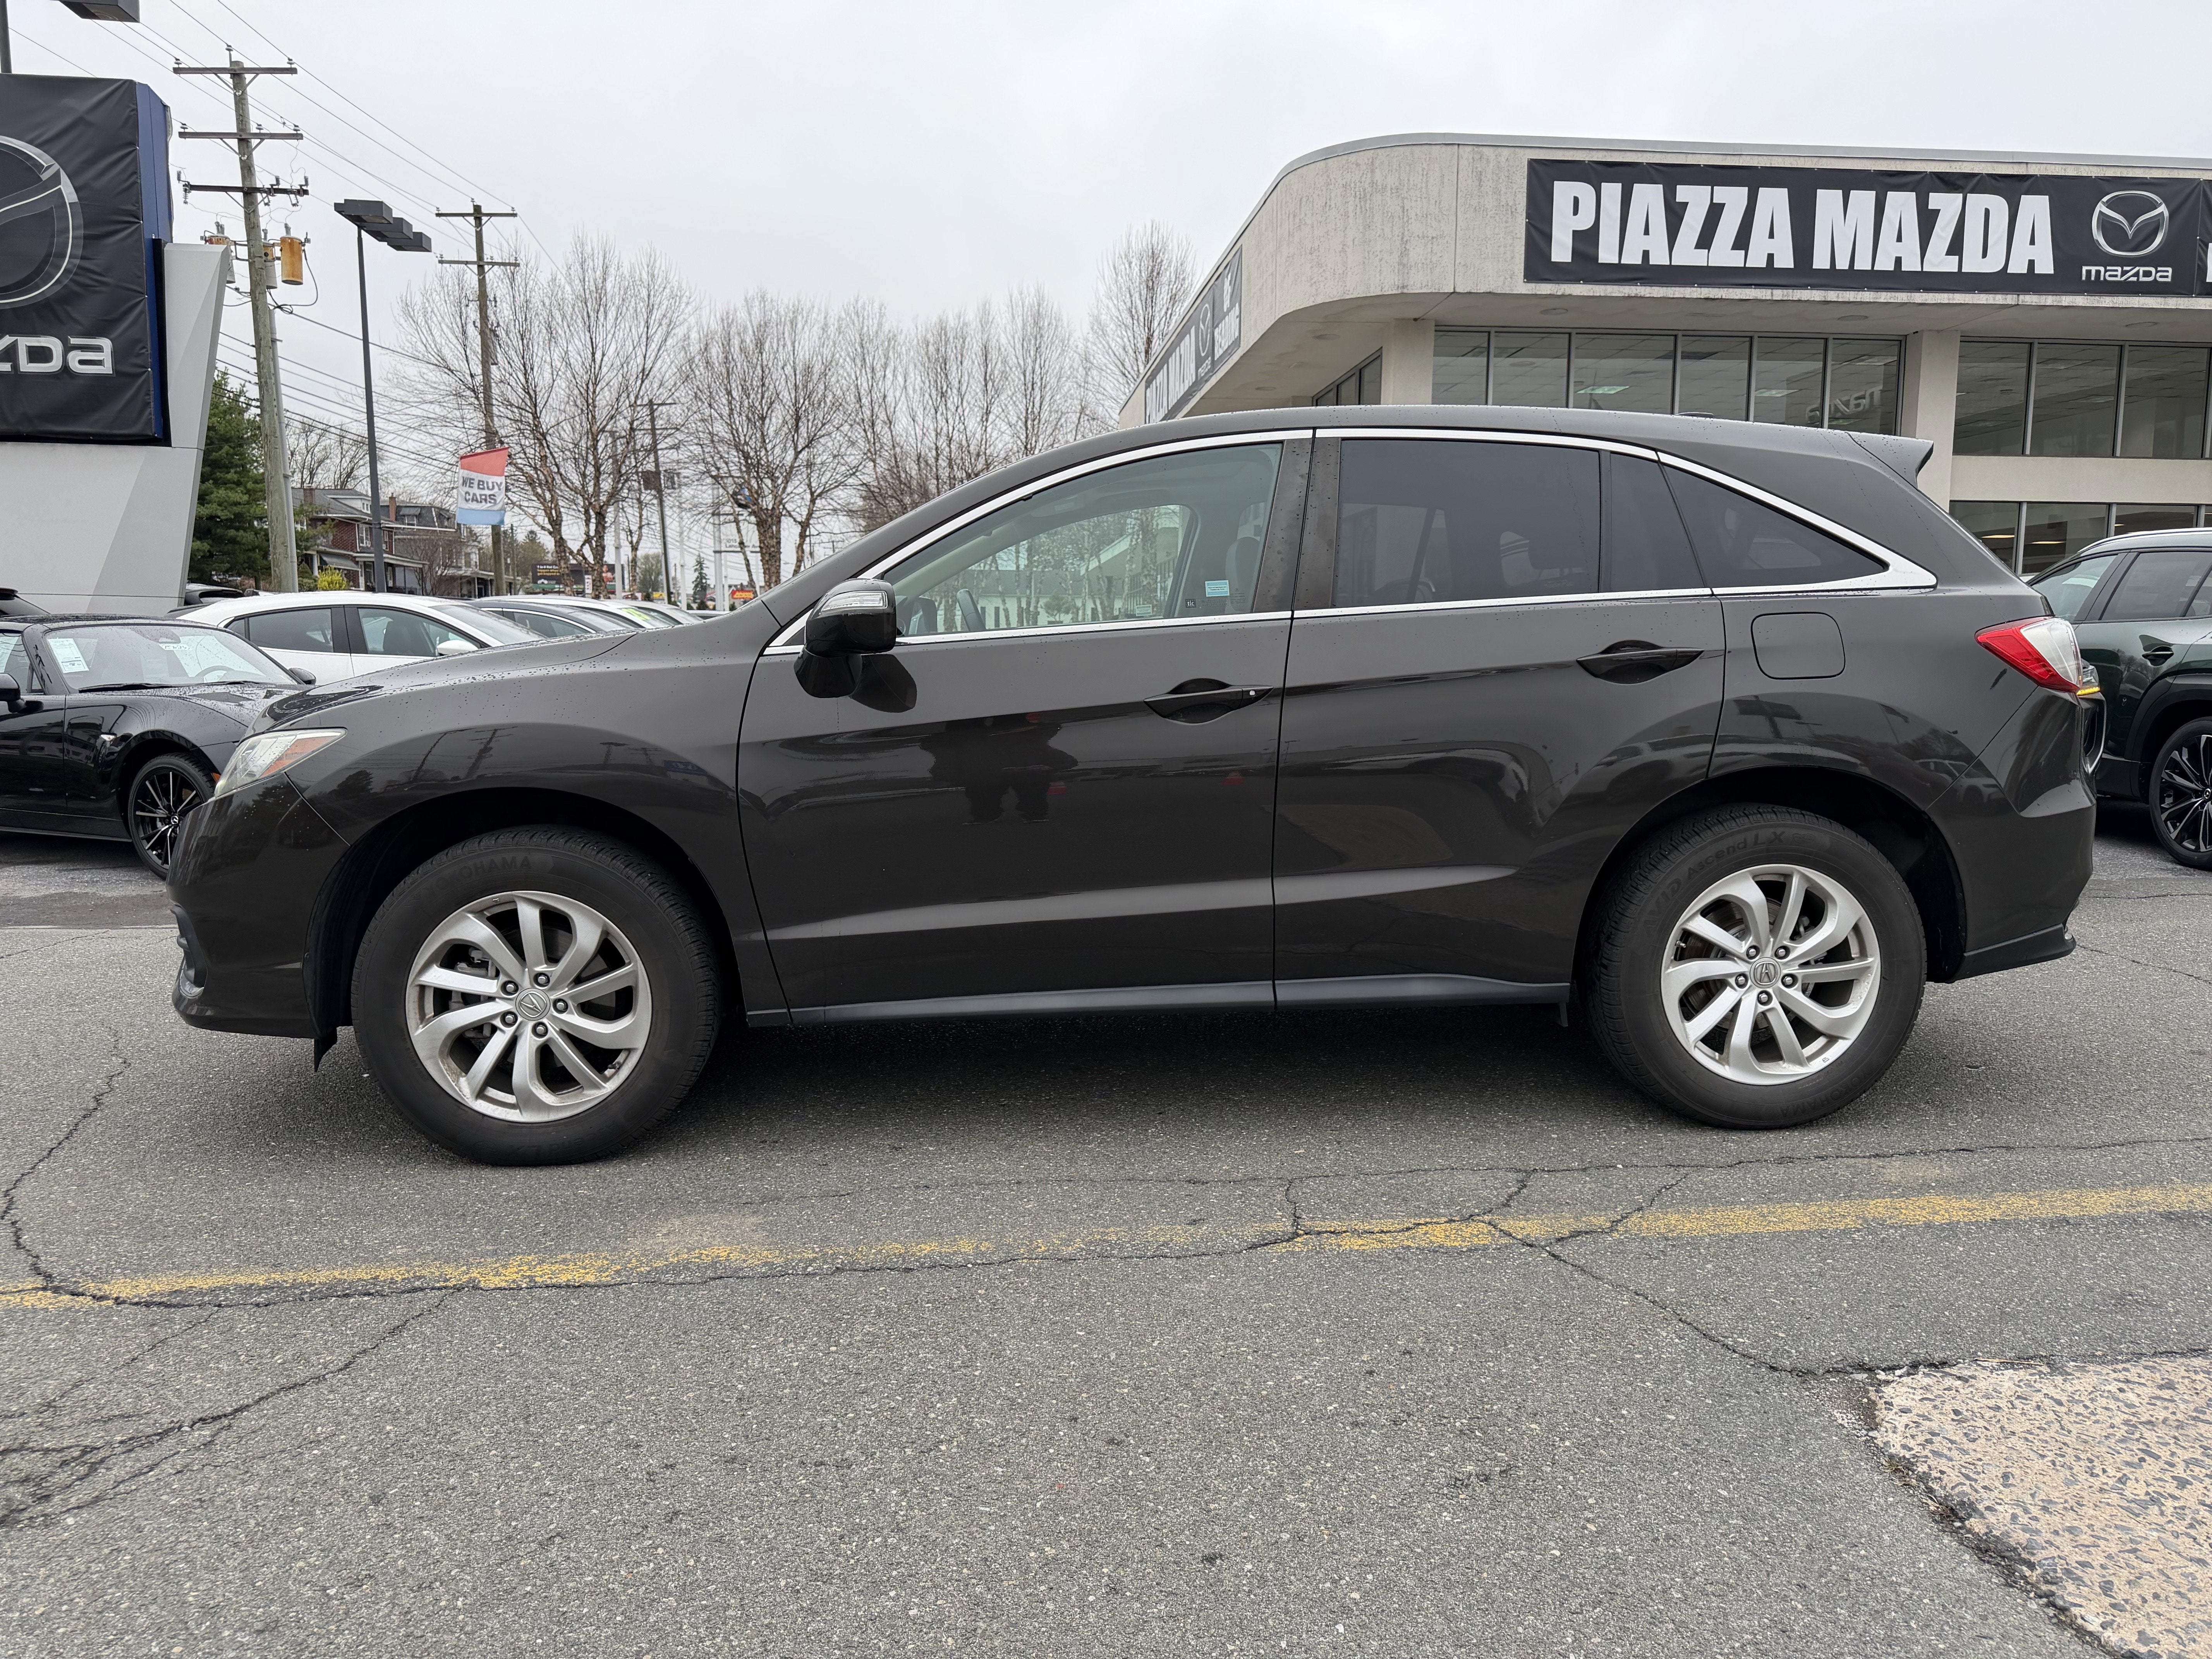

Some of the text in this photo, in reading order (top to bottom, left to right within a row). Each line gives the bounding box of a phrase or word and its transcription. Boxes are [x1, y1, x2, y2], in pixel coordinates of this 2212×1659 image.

[1551, 180, 2054, 274] PIAZZA MAZDA
[462, 476, 503, 491] WE BUY
[464, 491, 498, 504] CARS
[421, 855, 531, 898] YOKOHAMA
[1687, 838, 1748, 880] Ascend
[1753, 831, 1786, 847] LX
